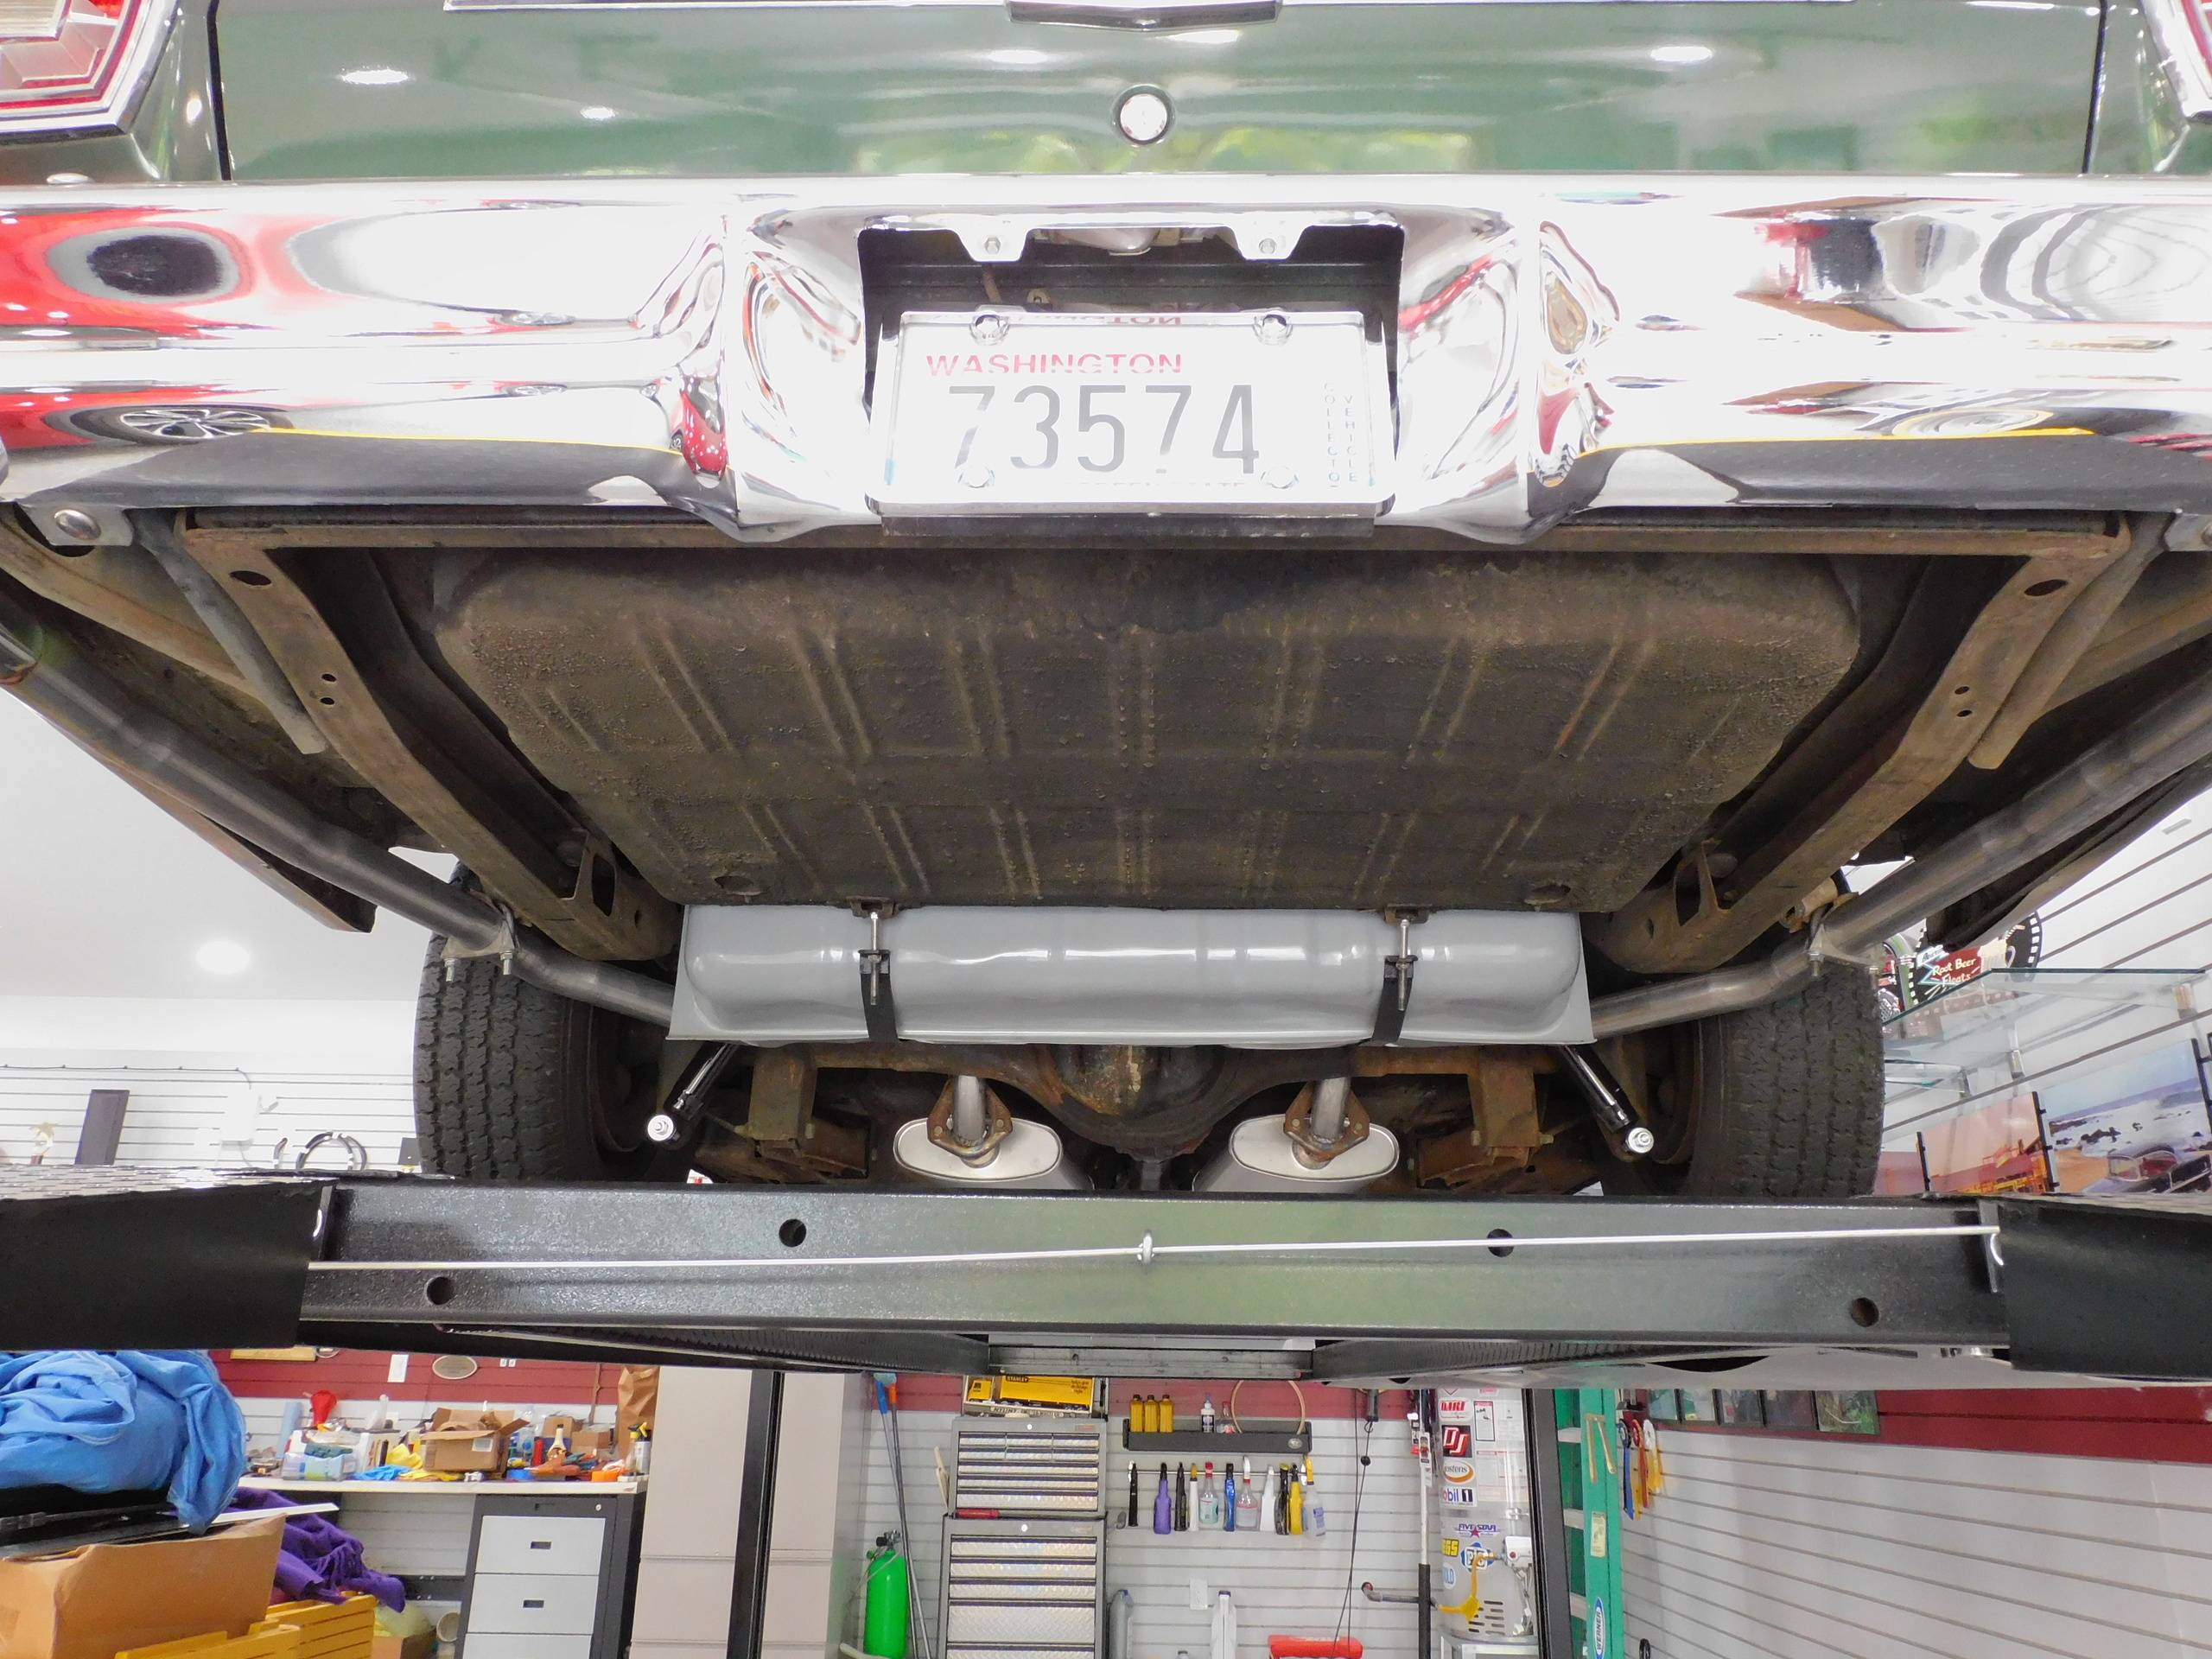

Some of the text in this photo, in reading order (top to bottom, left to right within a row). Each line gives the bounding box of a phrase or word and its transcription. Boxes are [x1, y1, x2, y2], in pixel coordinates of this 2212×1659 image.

[926, 353, 1182, 377] WASHINGTON
[949, 385, 1260, 474] 73574
[1932, 957, 1977, 976] Root Beer
